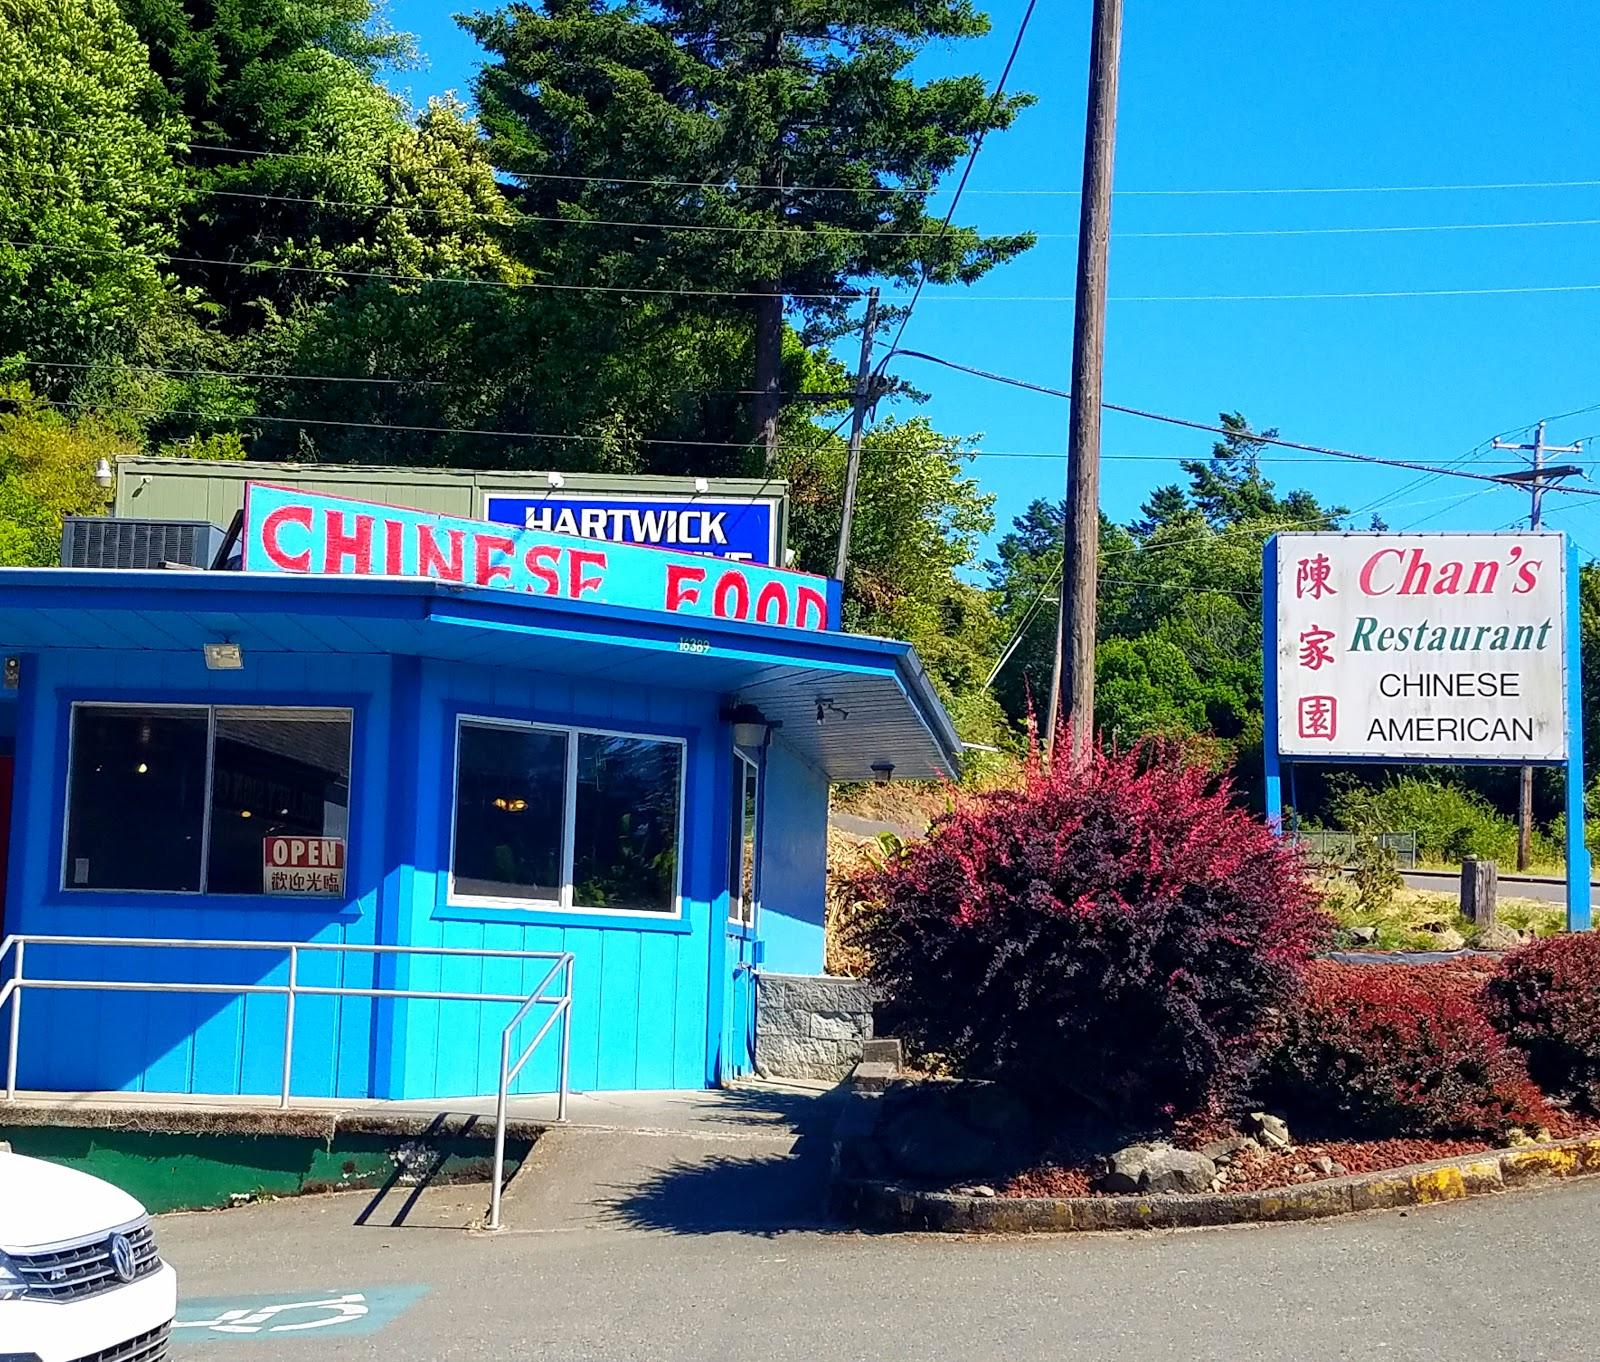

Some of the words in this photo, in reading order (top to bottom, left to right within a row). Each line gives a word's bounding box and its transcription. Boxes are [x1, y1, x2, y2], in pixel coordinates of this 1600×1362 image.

[525, 506, 727, 544] HARTWICK
[261, 504, 608, 601] CHINESE
[665, 564, 828, 632] FOOD
[1358, 546, 1544, 596] Chan's
[1296, 552, 1338, 741] 陳家園
[1346, 616, 1552, 652] Restaurant
[1379, 672, 1520, 698] CHINESE
[1366, 717, 1534, 742] AMERICAN
[272, 839, 337, 866] OPEN
